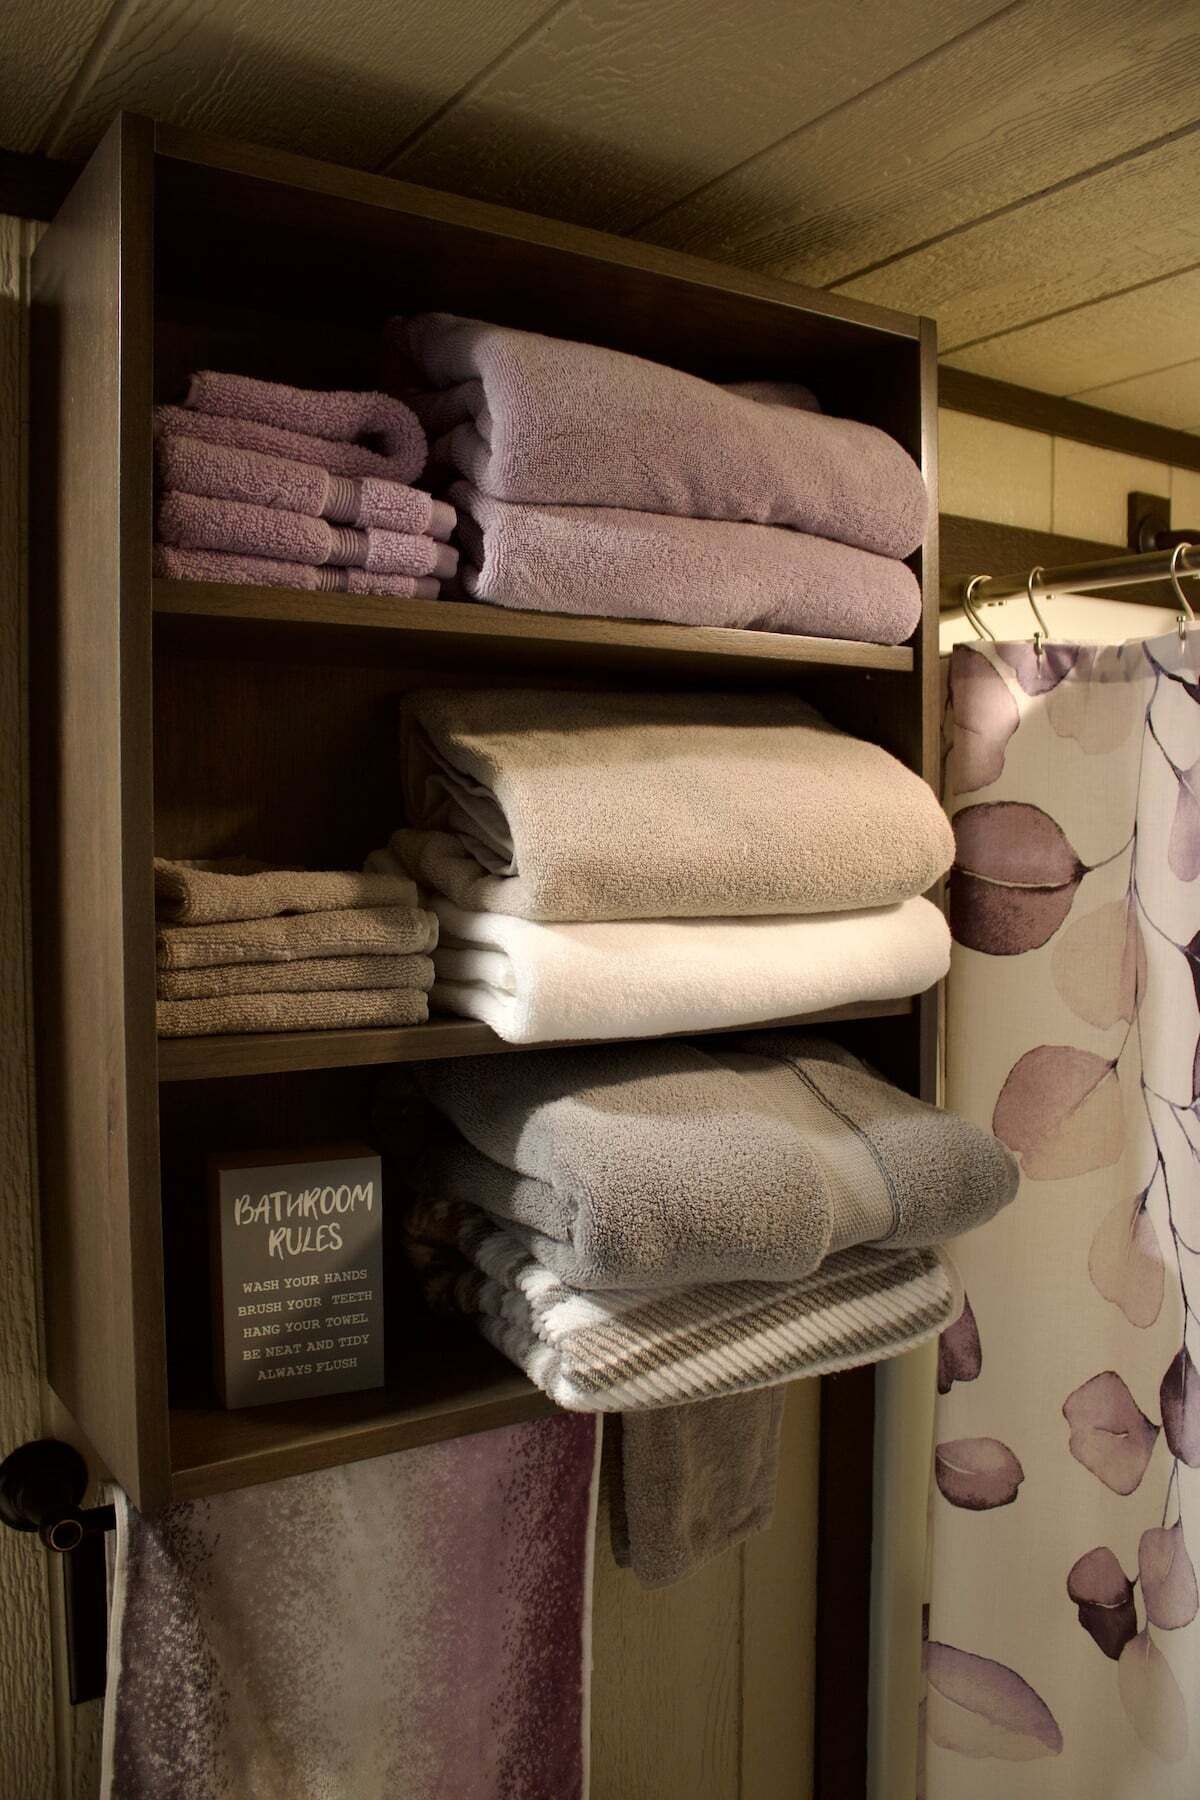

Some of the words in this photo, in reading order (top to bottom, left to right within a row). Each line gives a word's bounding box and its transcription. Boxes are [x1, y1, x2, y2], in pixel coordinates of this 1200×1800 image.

[234, 1181, 374, 1226] BATHROOM
[269, 1222, 344, 1261] RULES
[243, 1280, 279, 1293] WASH
[284, 1276, 319, 1289] YOUR
[324, 1269, 368, 1284] HANDS
[238, 1302, 282, 1317] BRUSH
[287, 1298, 322, 1310] YOUR
[331, 1291, 373, 1305] TEETH
[243, 1325, 280, 1339] HANG
[285, 1320, 320, 1332] YOUR
[325, 1313, 369, 1328] TOWEL
[243, 1349, 261, 1361] BE
[265, 1343, 301, 1358] NEAT
[307, 1340, 334, 1352] AND
[339, 1334, 370, 1348] TIDY
[257, 1365, 312, 1381] ALWAYS
[316, 1358, 358, 1372] FLUSH
